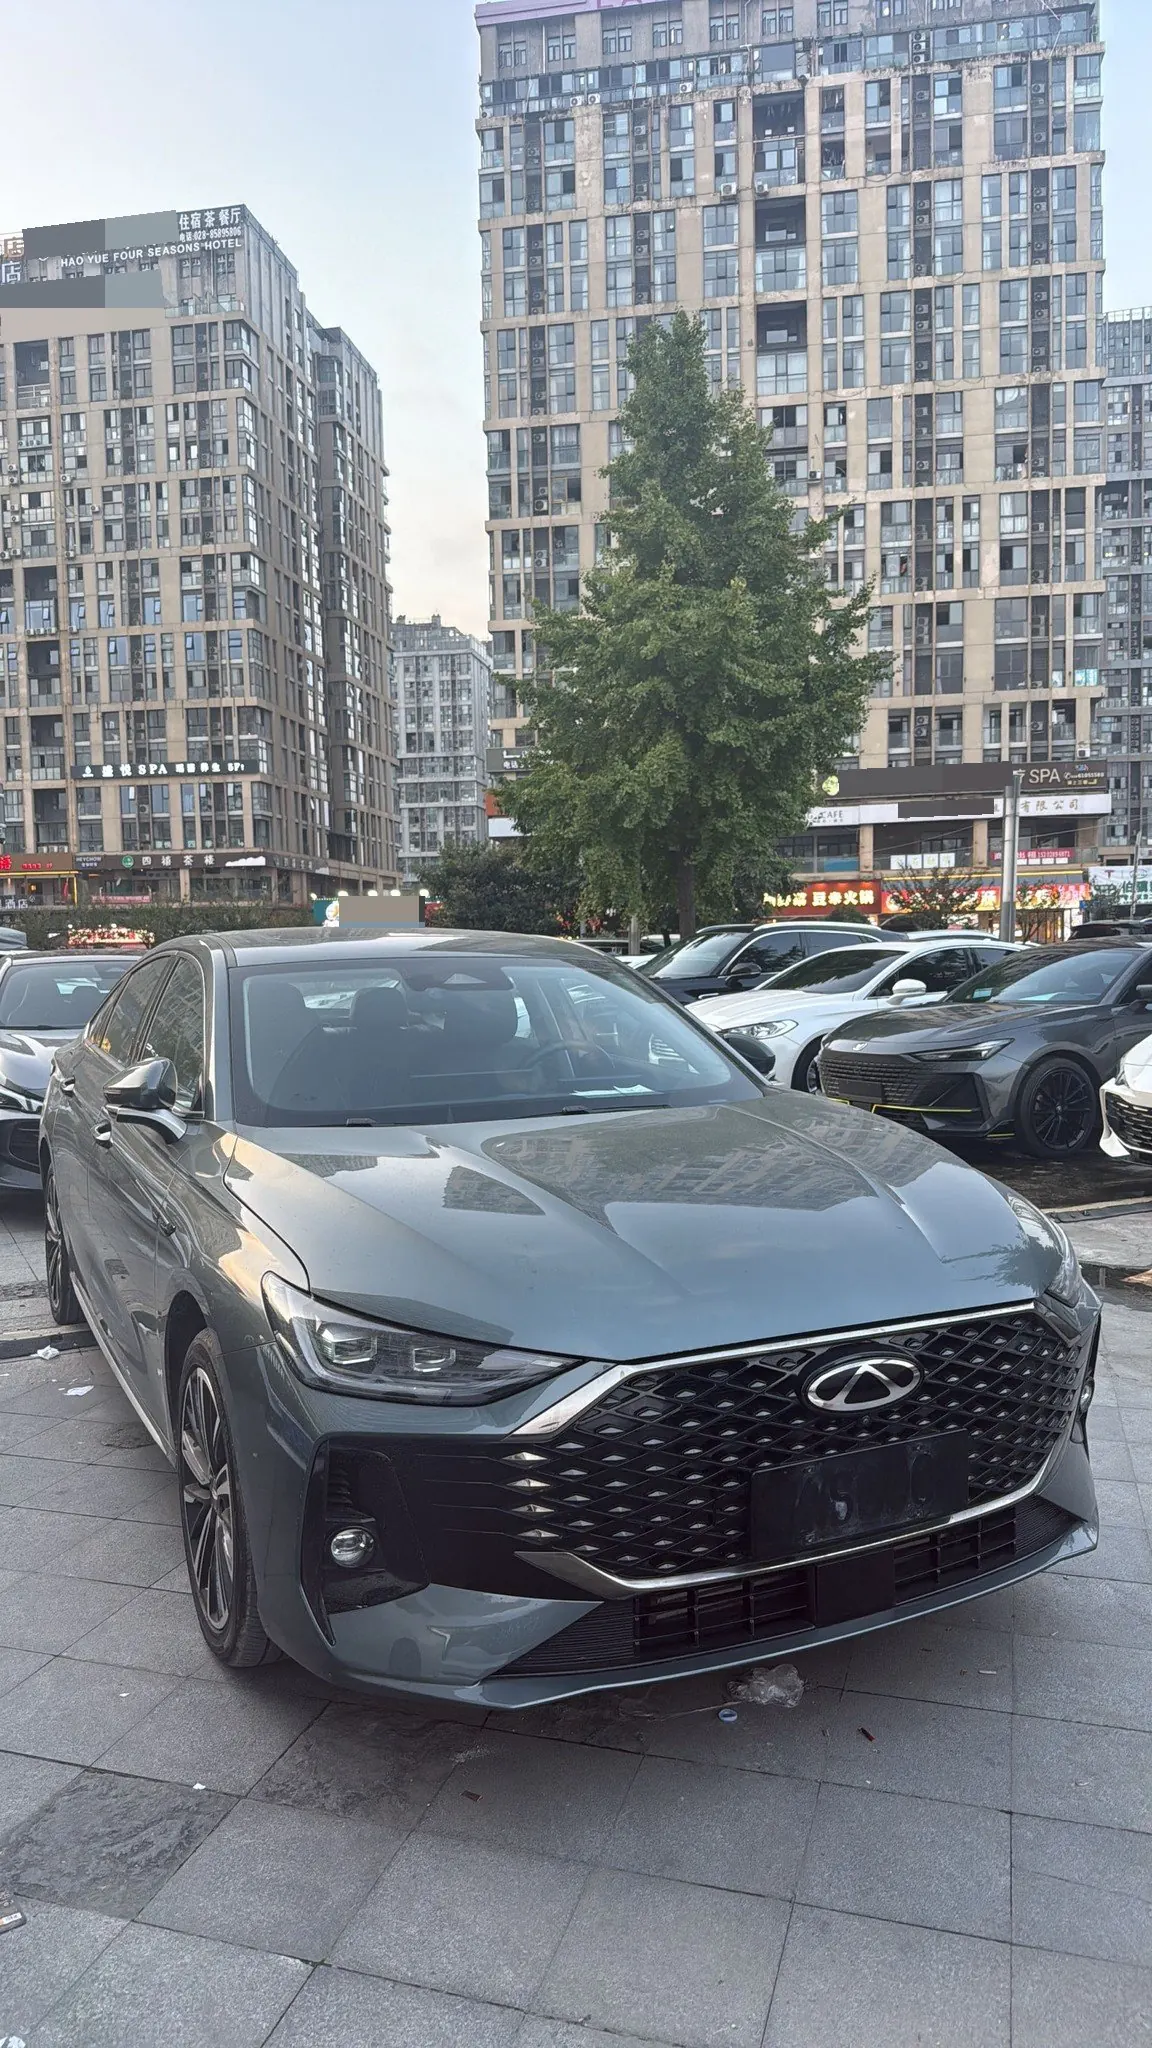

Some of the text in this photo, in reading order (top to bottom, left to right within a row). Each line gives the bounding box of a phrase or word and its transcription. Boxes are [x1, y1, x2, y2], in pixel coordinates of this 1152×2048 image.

[61, 238, 242, 268] HAO YUE FOUR SEASONS HOTEL
[138, 763, 168, 775] SPA
[1029, 768, 1061, 784] SPA
[1021, 799, 1078, 812] 有限公司
